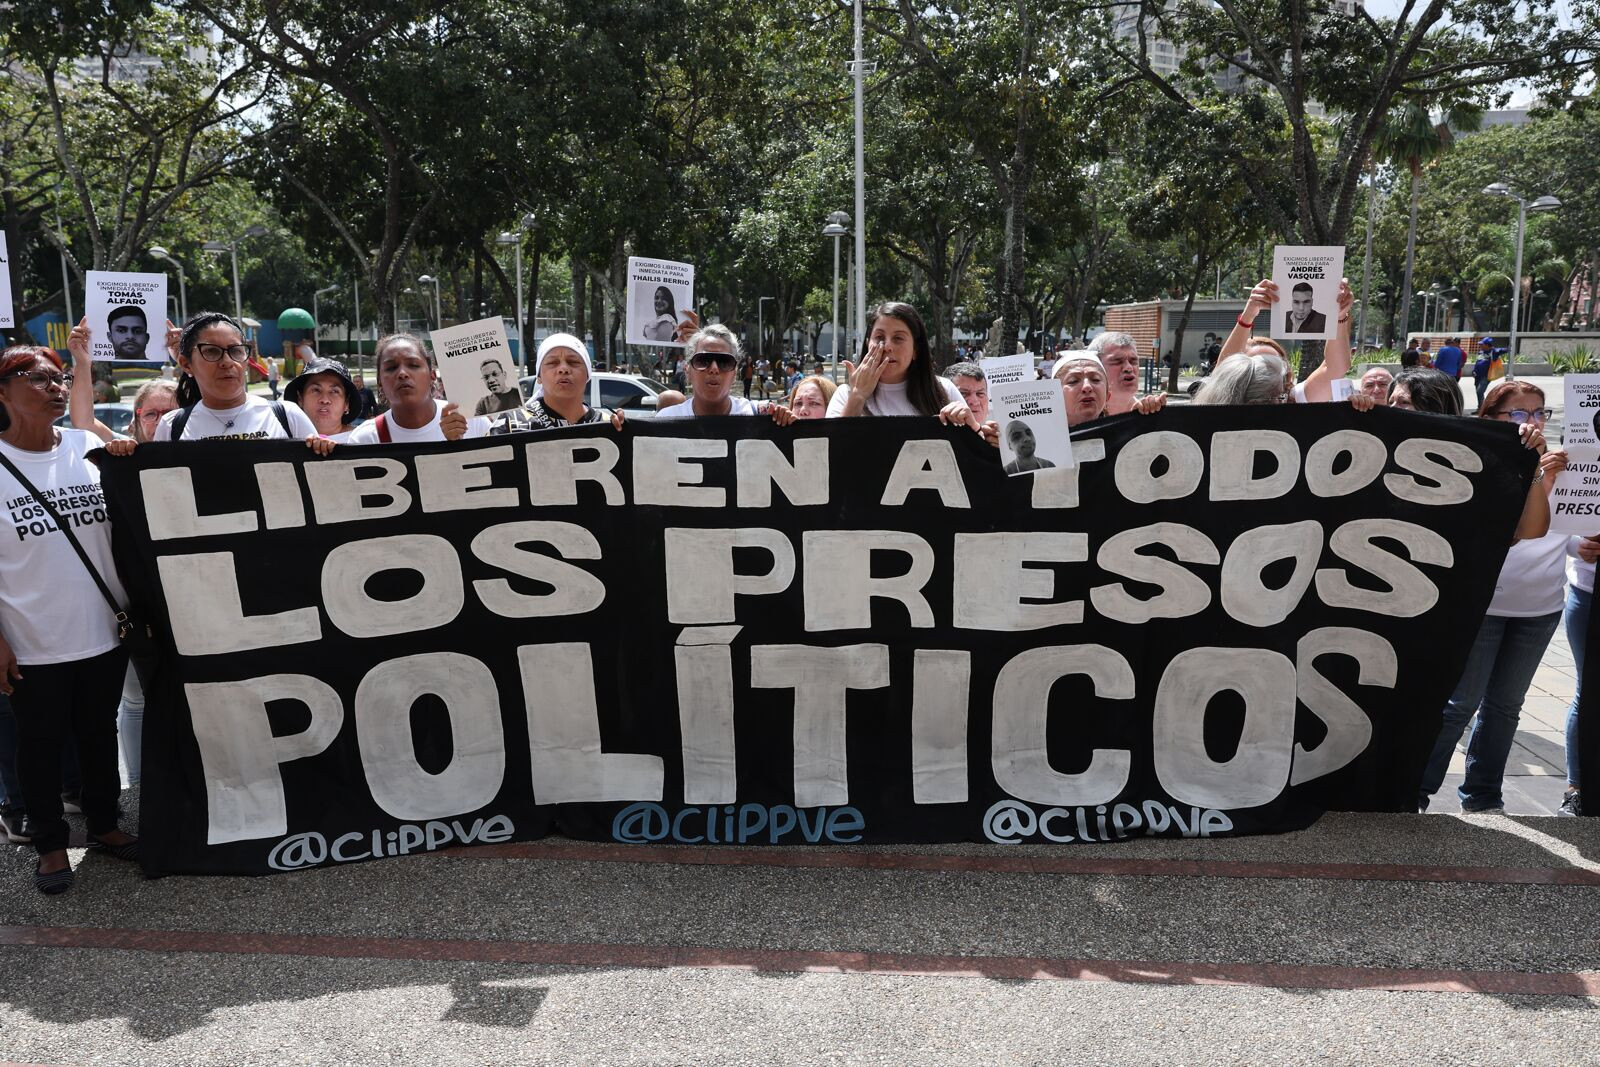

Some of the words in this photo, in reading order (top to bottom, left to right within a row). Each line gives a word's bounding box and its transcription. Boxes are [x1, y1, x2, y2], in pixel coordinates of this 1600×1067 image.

[1290, 264, 1323, 272] ANDRÉS
[662, 278, 690, 286] BERRIO
[108, 290, 143, 298] TOMÁS
[444, 336, 470, 347] EXIGIMOS
[470, 330, 497, 340] LIBERTAD
[448, 340, 478, 350] INMEDIATA
[478, 336, 494, 344] PARA
[446, 346, 478, 358] WILGER
[480, 340, 501, 350] LEAL
[988, 372, 1024, 380] EMMANUEL
[1001, 393, 1028, 401] EXIGIMOS
[1020, 402, 1039, 410] LUIS
[1008, 408, 1053, 419] QUIÑONES
[139, 436, 829, 541] LIBEREN
[880, 439, 971, 509] A
[1030, 430, 1483, 509] TODOS
[1582, 476, 1600, 484] SIN
[6, 489, 56, 510] LIBEEN
[59, 488, 68, 496] A
[68, 483, 102, 494] TODOS
[1554, 488, 1568, 496] MI
[11, 504, 44, 523] LOS
[157, 521, 606, 655] LOS
[664, 518, 1454, 632] PRESOS
[184, 625, 1398, 845] POLÍTICOS
